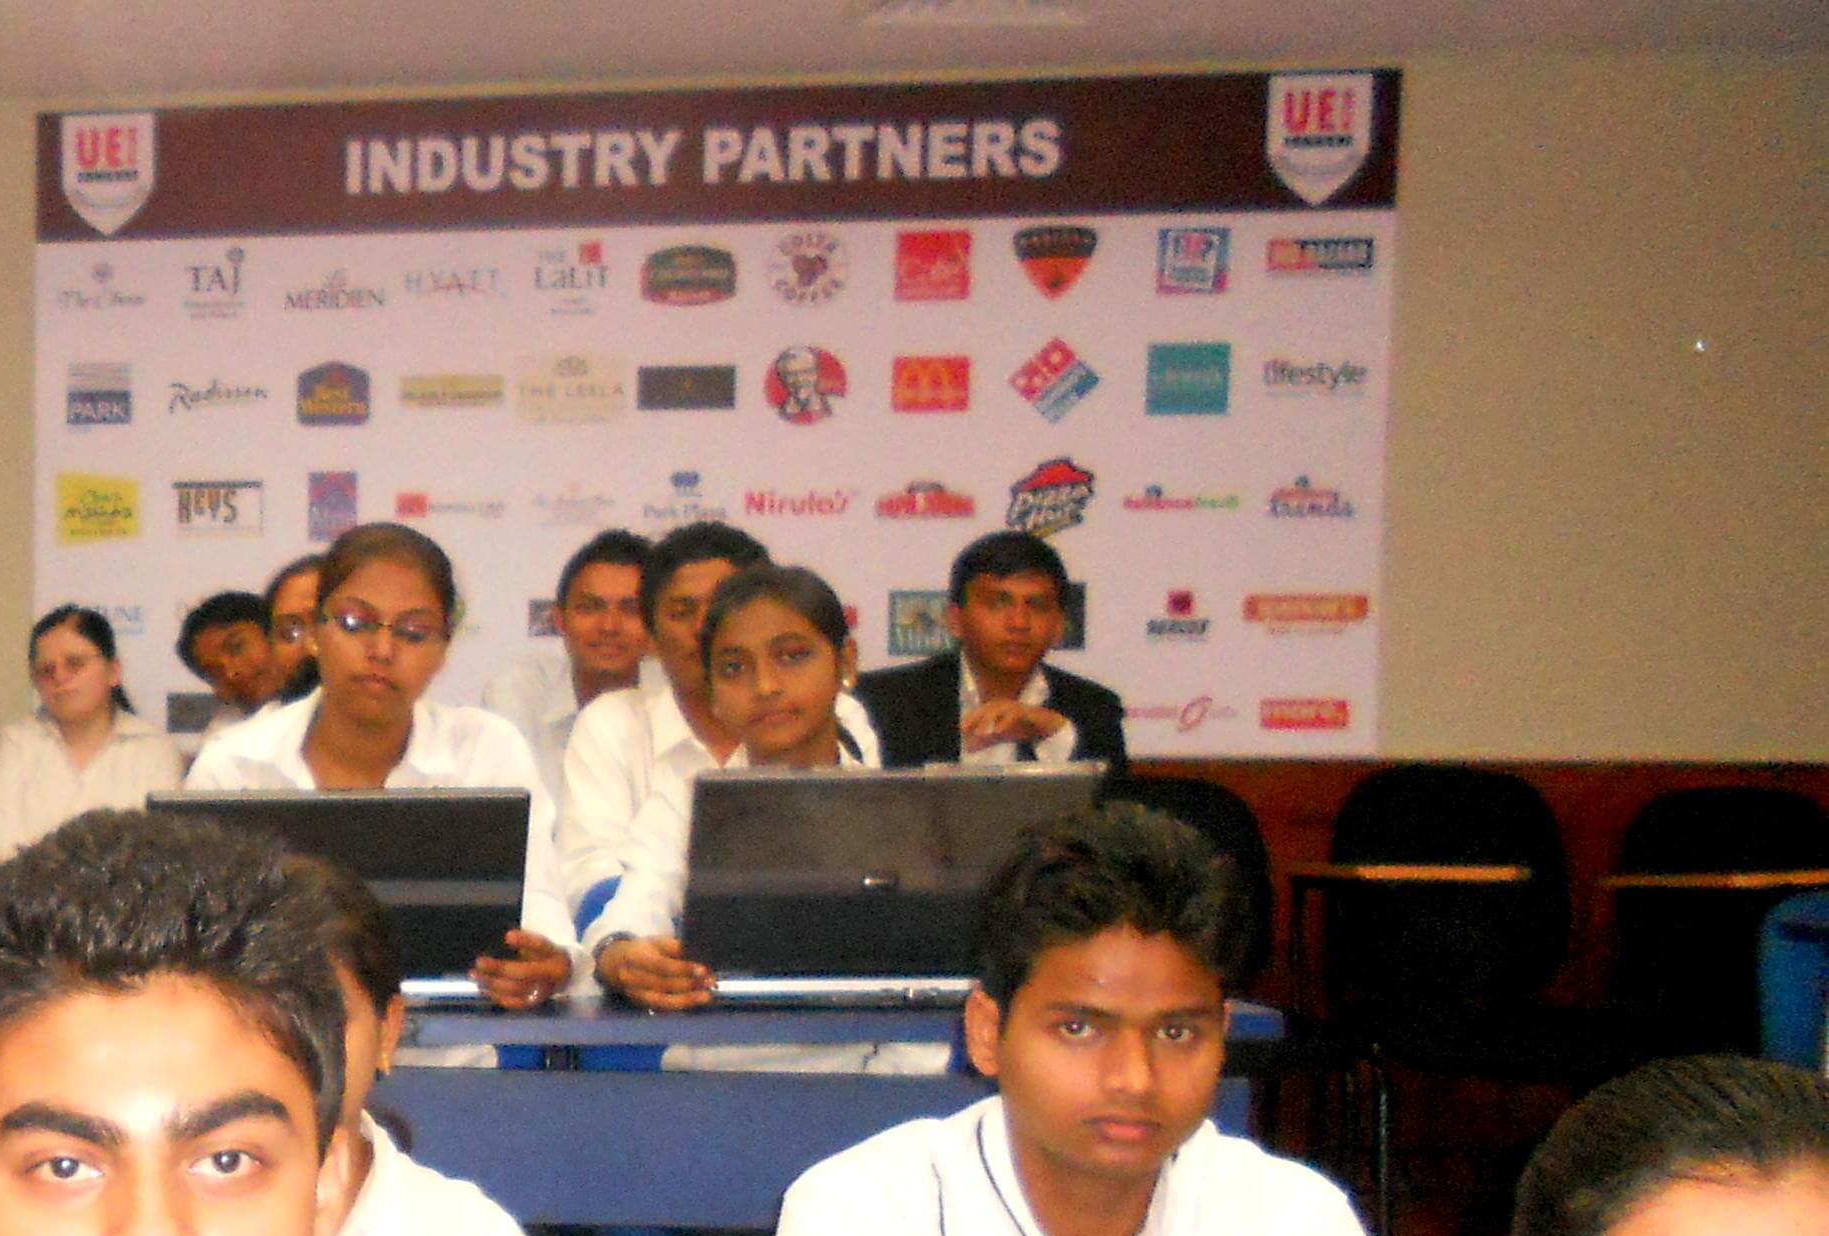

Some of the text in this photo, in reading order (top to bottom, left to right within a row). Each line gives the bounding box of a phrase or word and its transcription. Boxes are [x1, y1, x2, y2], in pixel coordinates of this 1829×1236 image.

[346, 117, 1061, 194] INDUSTRY PARTNERS
[185, 258, 242, 294] TAJ
[404, 268, 500, 297] HYATT
[283, 288, 386, 310] MERIDIEN
[71, 400, 128, 419] PARK
